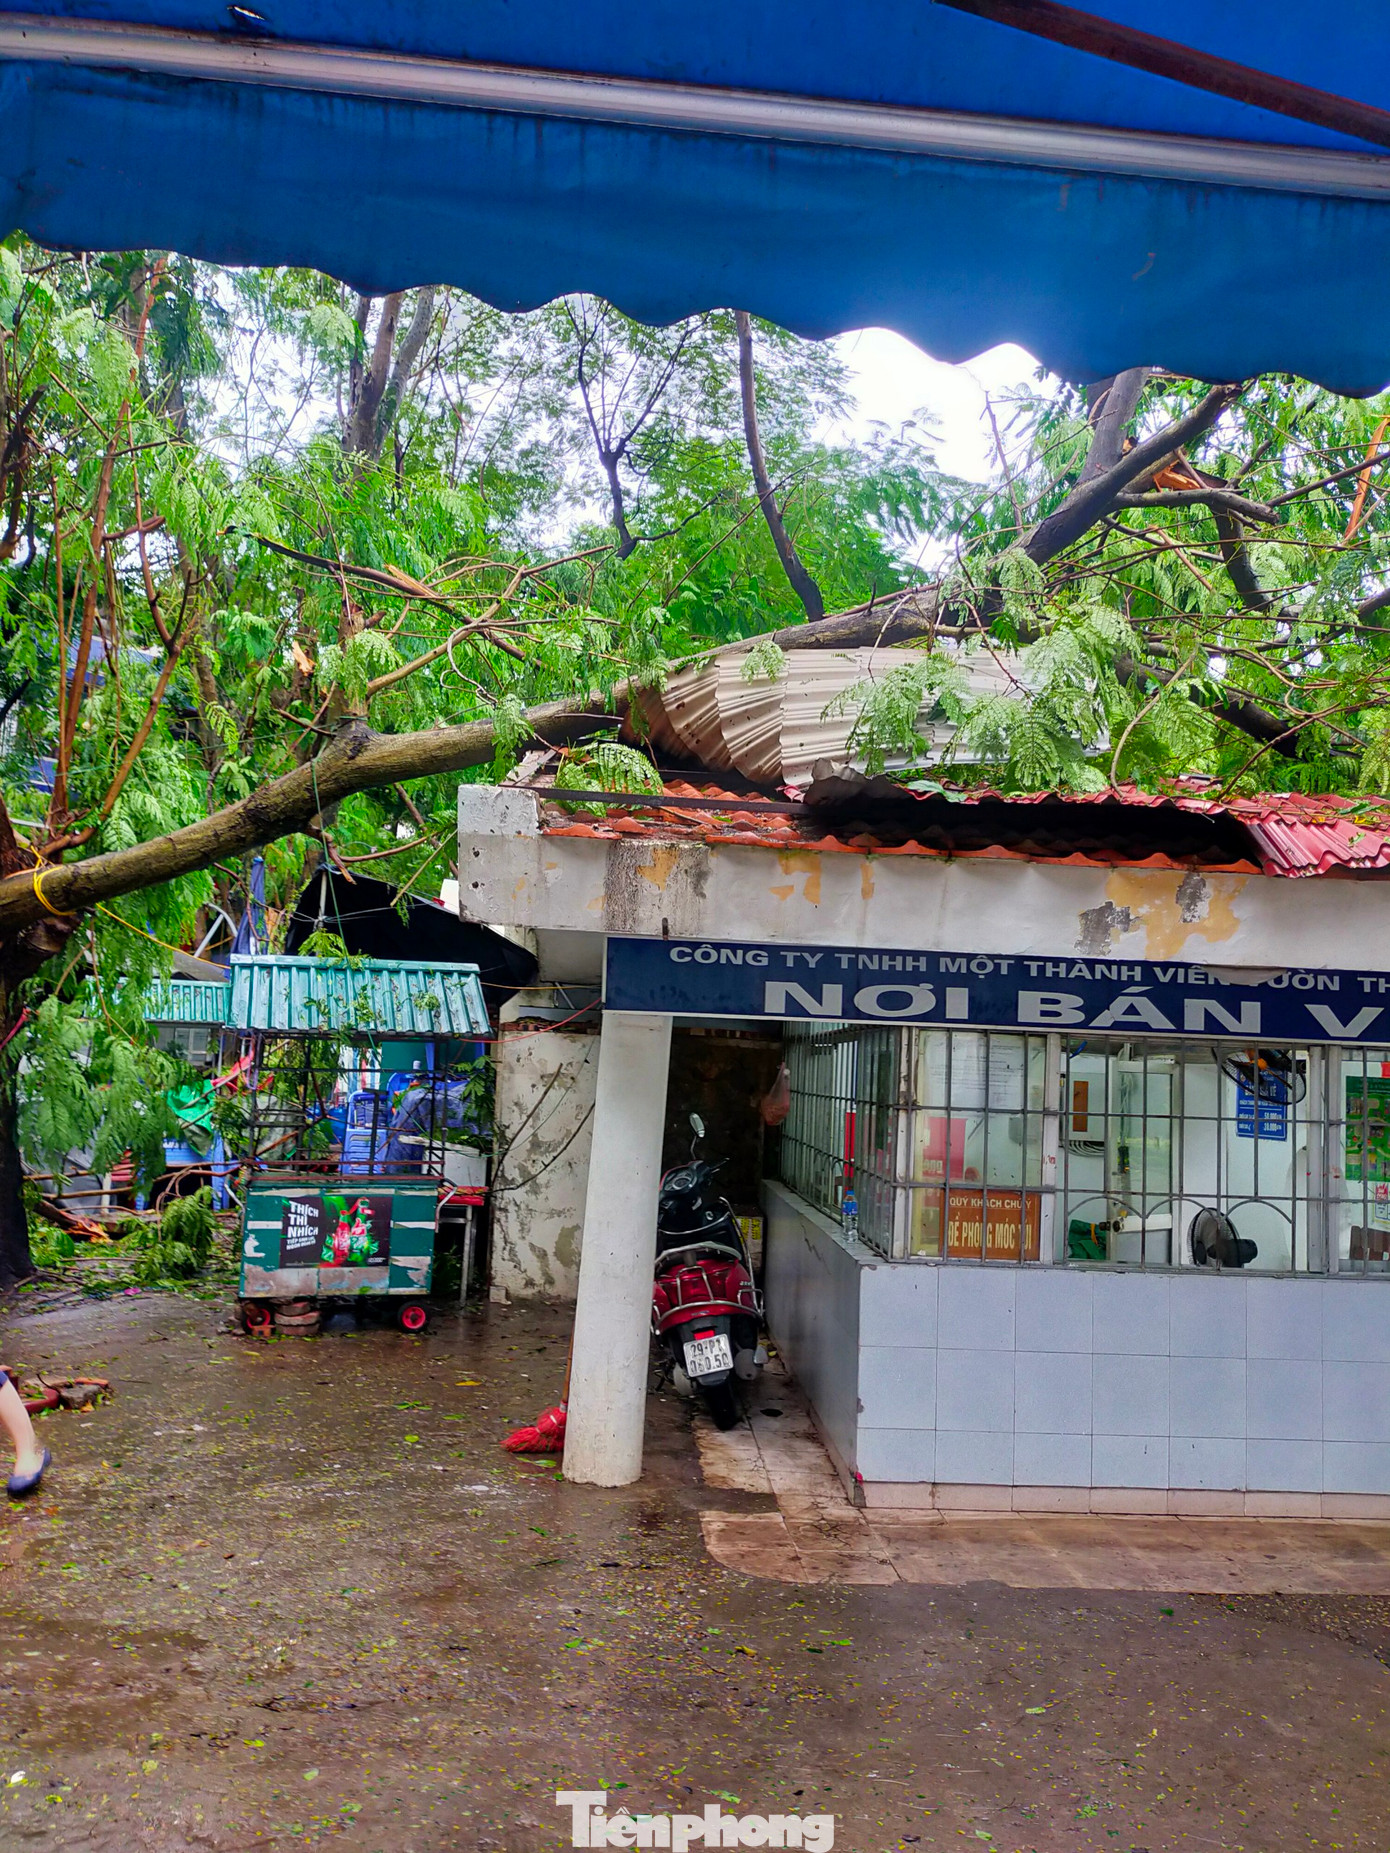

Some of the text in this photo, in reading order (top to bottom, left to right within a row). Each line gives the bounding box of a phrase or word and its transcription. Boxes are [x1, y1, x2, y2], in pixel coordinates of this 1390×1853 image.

[669, 943, 769, 966] CÔNG
[780, 950, 824, 968] TY
[835, 953, 927, 972] TNHH
[939, 954, 1015, 979] MỘT
[1024, 957, 1142, 982] THÀNH
[1247, 969, 1340, 991] ƯỜN
[764, 981, 1385, 1038] NƠI BÁN V
[288, 1200, 319, 1218] THÍCH
[949, 1195, 968, 1206] QUÝ
[971, 1198, 1002, 1208] KHCH
[287, 1213, 308, 1226] THÌ
[287, 1225, 319, 1239] NHÍCH
[995, 1217, 1016, 1250] MÓC
